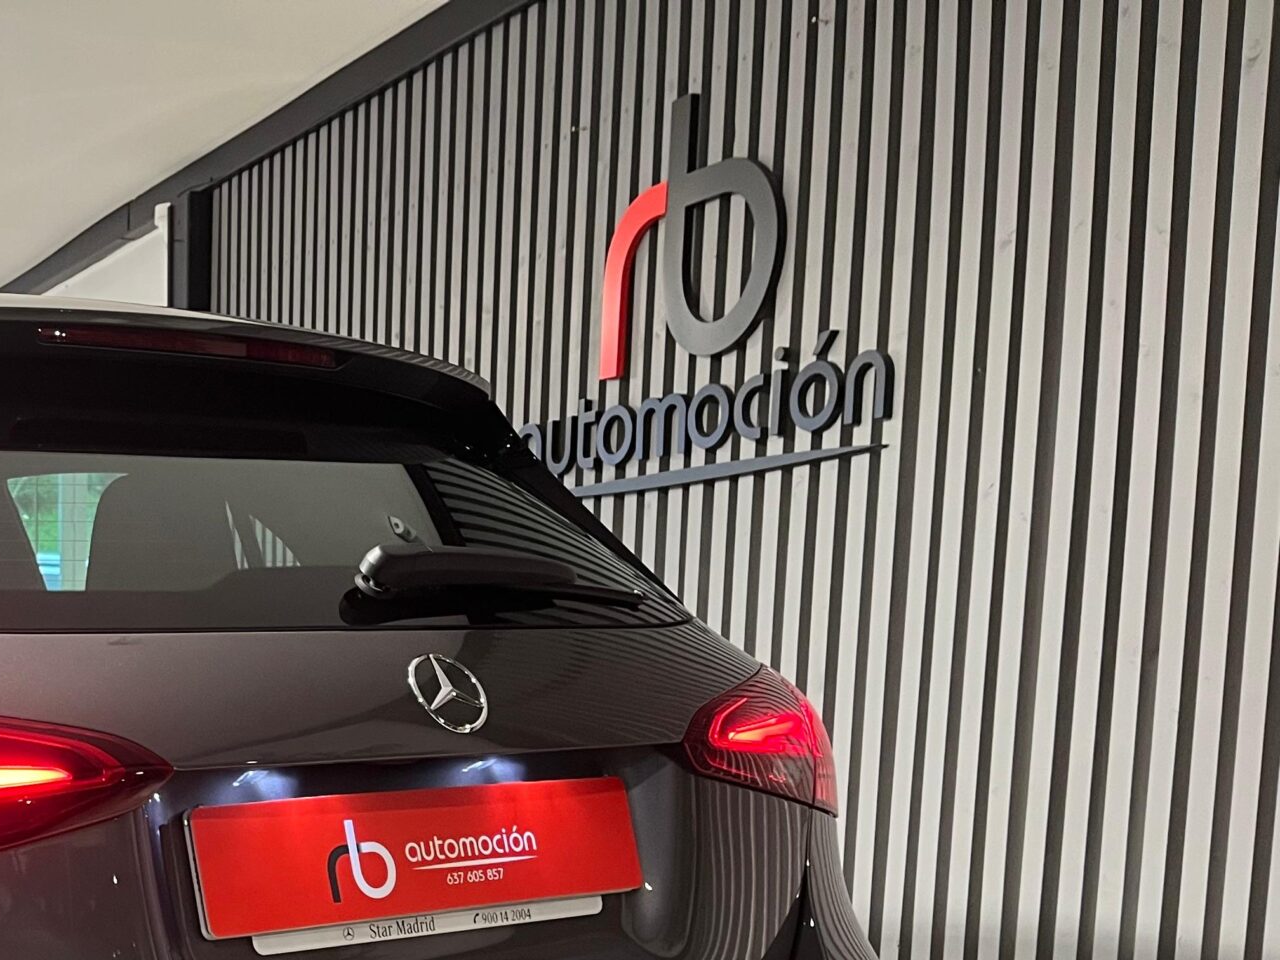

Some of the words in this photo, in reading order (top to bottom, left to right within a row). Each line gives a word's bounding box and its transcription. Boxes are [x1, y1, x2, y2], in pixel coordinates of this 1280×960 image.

[405, 825, 537, 862] automoción
[327, 820, 397, 903] rb
[447, 871, 464, 885] 637
[467, 870, 485, 882] 605
[487, 868, 504, 881] 857
[369, 923, 393, 939] Star
[396, 915, 436, 936] Madrid
[481, 912, 498, 924] 900
[499, 910, 509, 923] 14
[511, 908, 531, 921] 2004
